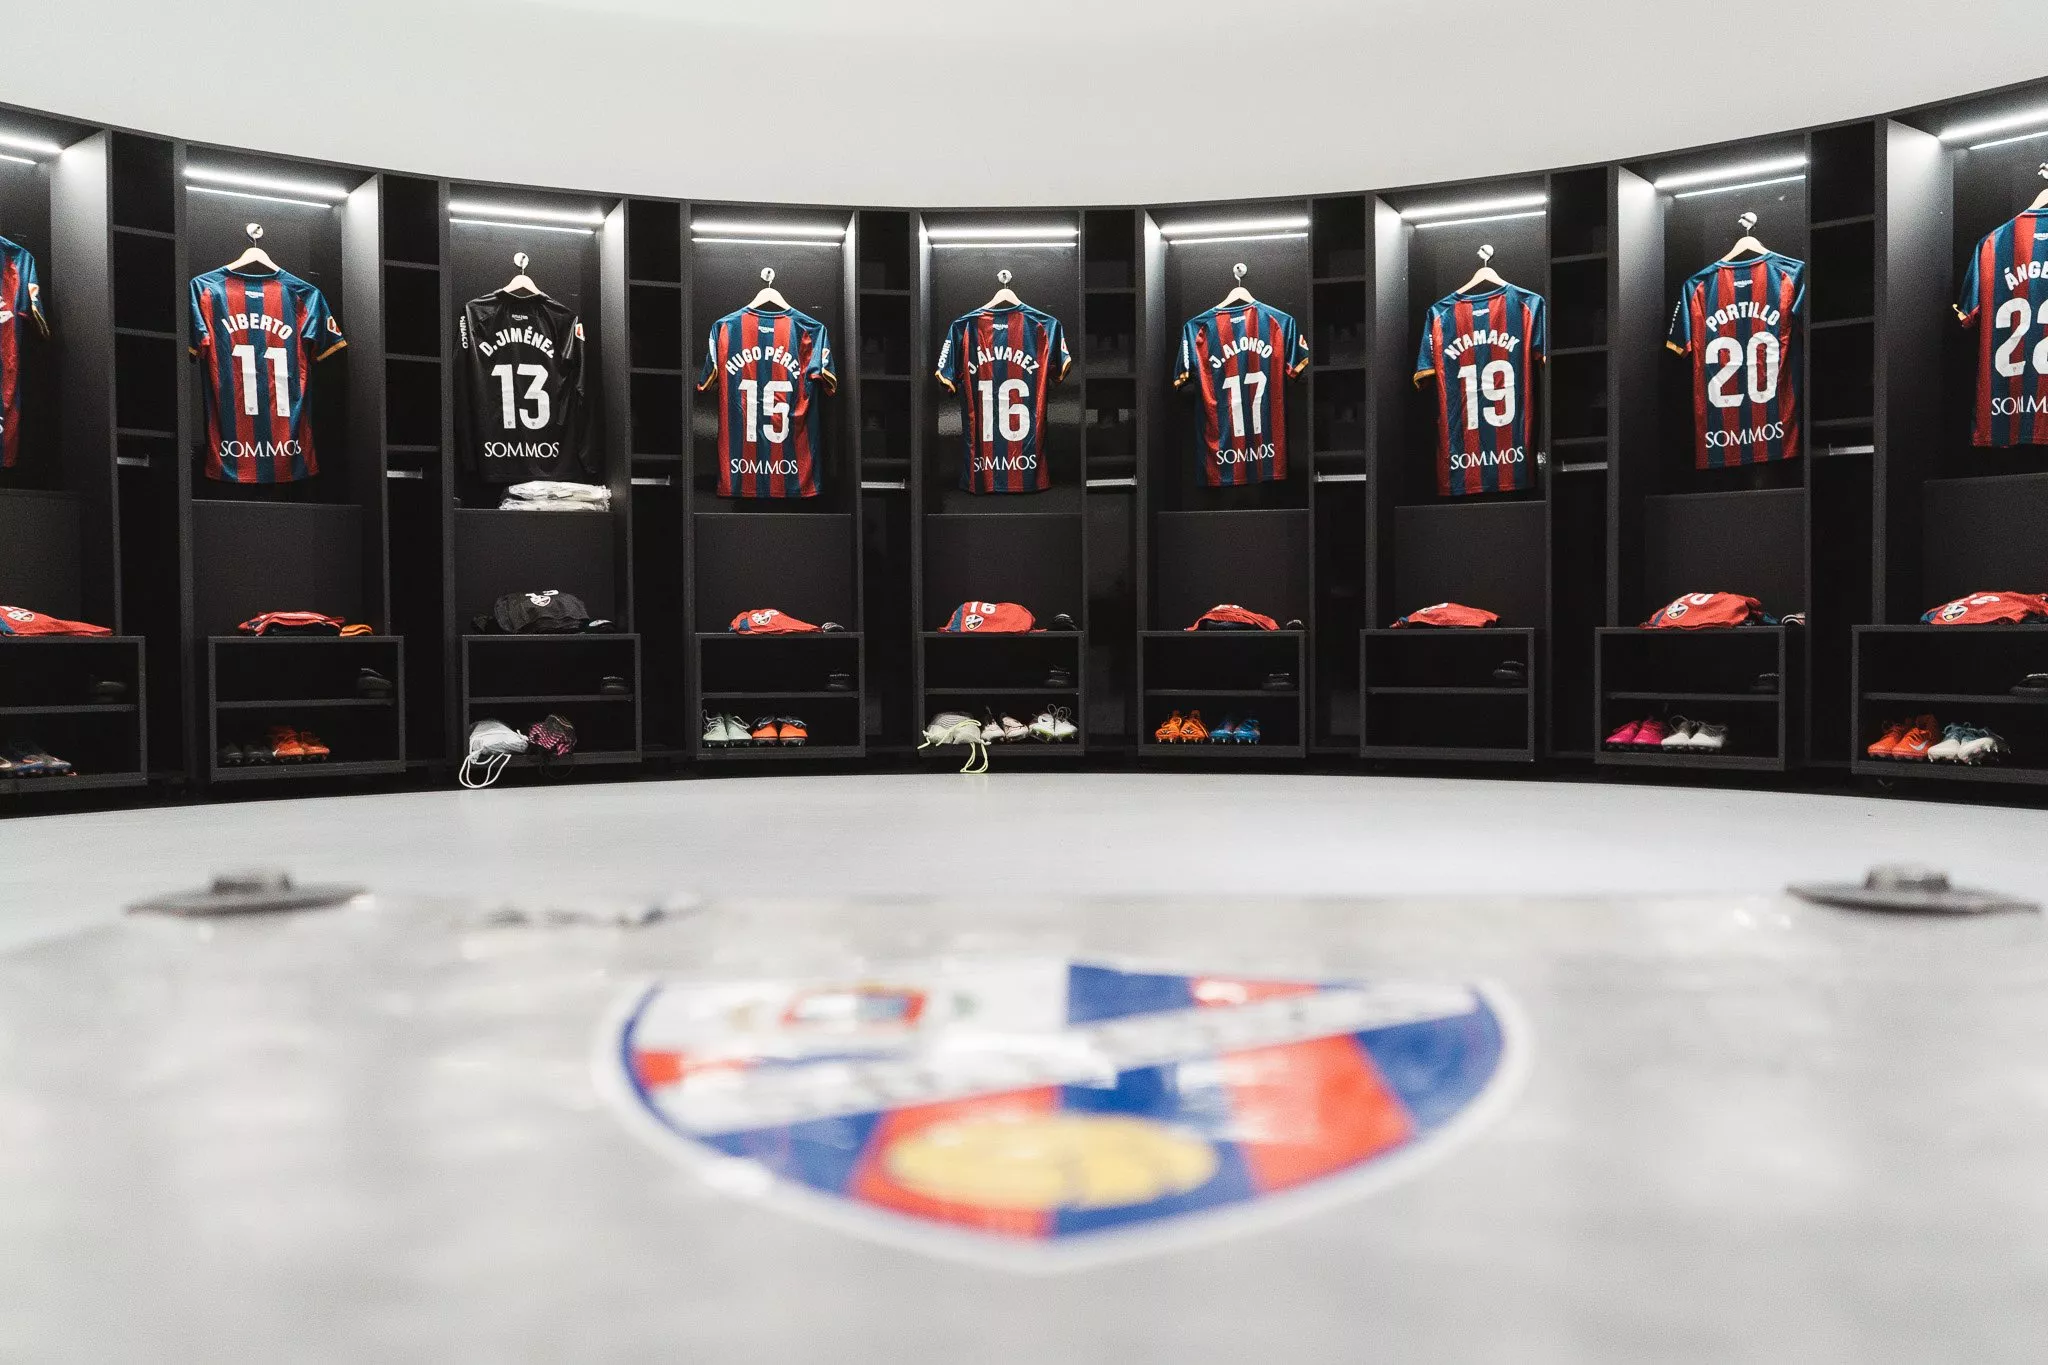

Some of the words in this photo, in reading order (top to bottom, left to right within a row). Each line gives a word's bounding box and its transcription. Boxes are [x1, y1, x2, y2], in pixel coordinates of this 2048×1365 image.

[221, 312, 293, 340] LIBERTO
[1705, 301, 1781, 333] PORTILLO
[725, 346, 762, 376] HUGO
[1443, 329, 1520, 361] NTAMACK
[231, 344, 291, 418] 11
[1705, 331, 1780, 408] 20
[491, 363, 551, 430] 13
[977, 378, 1031, 442] 16
[1221, 370, 1268, 438] 17
[1457, 359, 1515, 431] 19
[738, 379, 794, 444] 15
[219, 440, 302, 458] SOMMOS
[484, 441, 560, 458] SOMMOS
[1705, 420, 1785, 449] SOMMOS
[730, 458, 799, 475] SOMMOS
[1450, 445, 1525, 470] SOMMOS
[969, 601, 997, 615] 16
